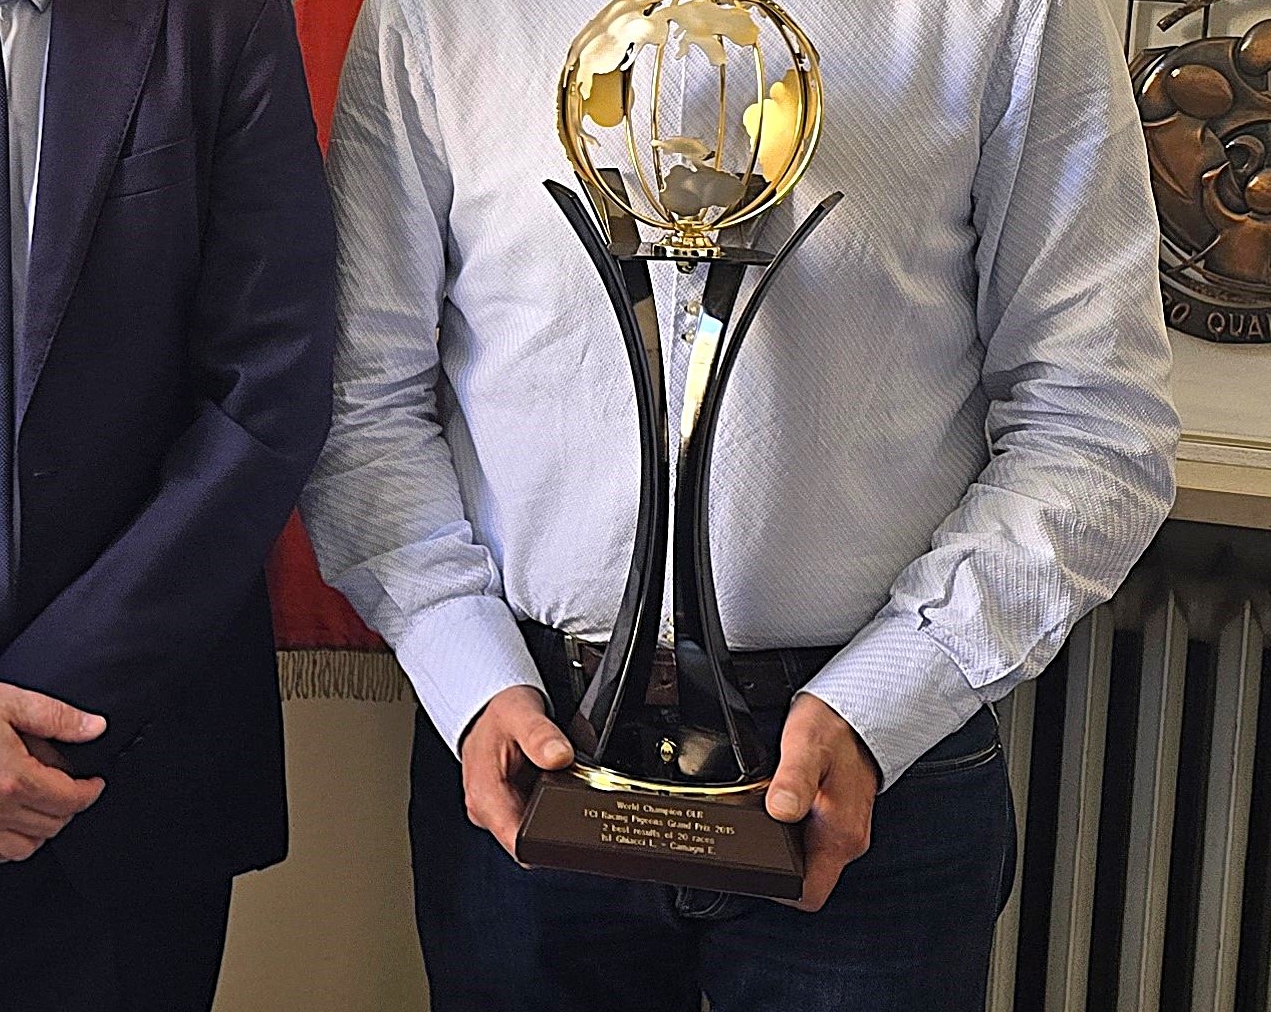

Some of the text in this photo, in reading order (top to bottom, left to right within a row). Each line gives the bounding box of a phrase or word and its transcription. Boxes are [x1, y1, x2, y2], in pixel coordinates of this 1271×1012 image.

[1207, 312, 1271, 342] QUA
[616, 800, 640, 812] World
[642, 804, 683, 817] Champion
[601, 810, 628, 824] Racing
[631, 814, 664, 827] Pigeons
[667, 819, 692, 831] Grand
[694, 822, 711, 833] Prix
[602, 823, 609, 832] 2
[611, 824, 630, 835] best
[633, 827, 661, 839] results
[677, 830, 688, 841] 20
[691, 834, 715, 845] races
